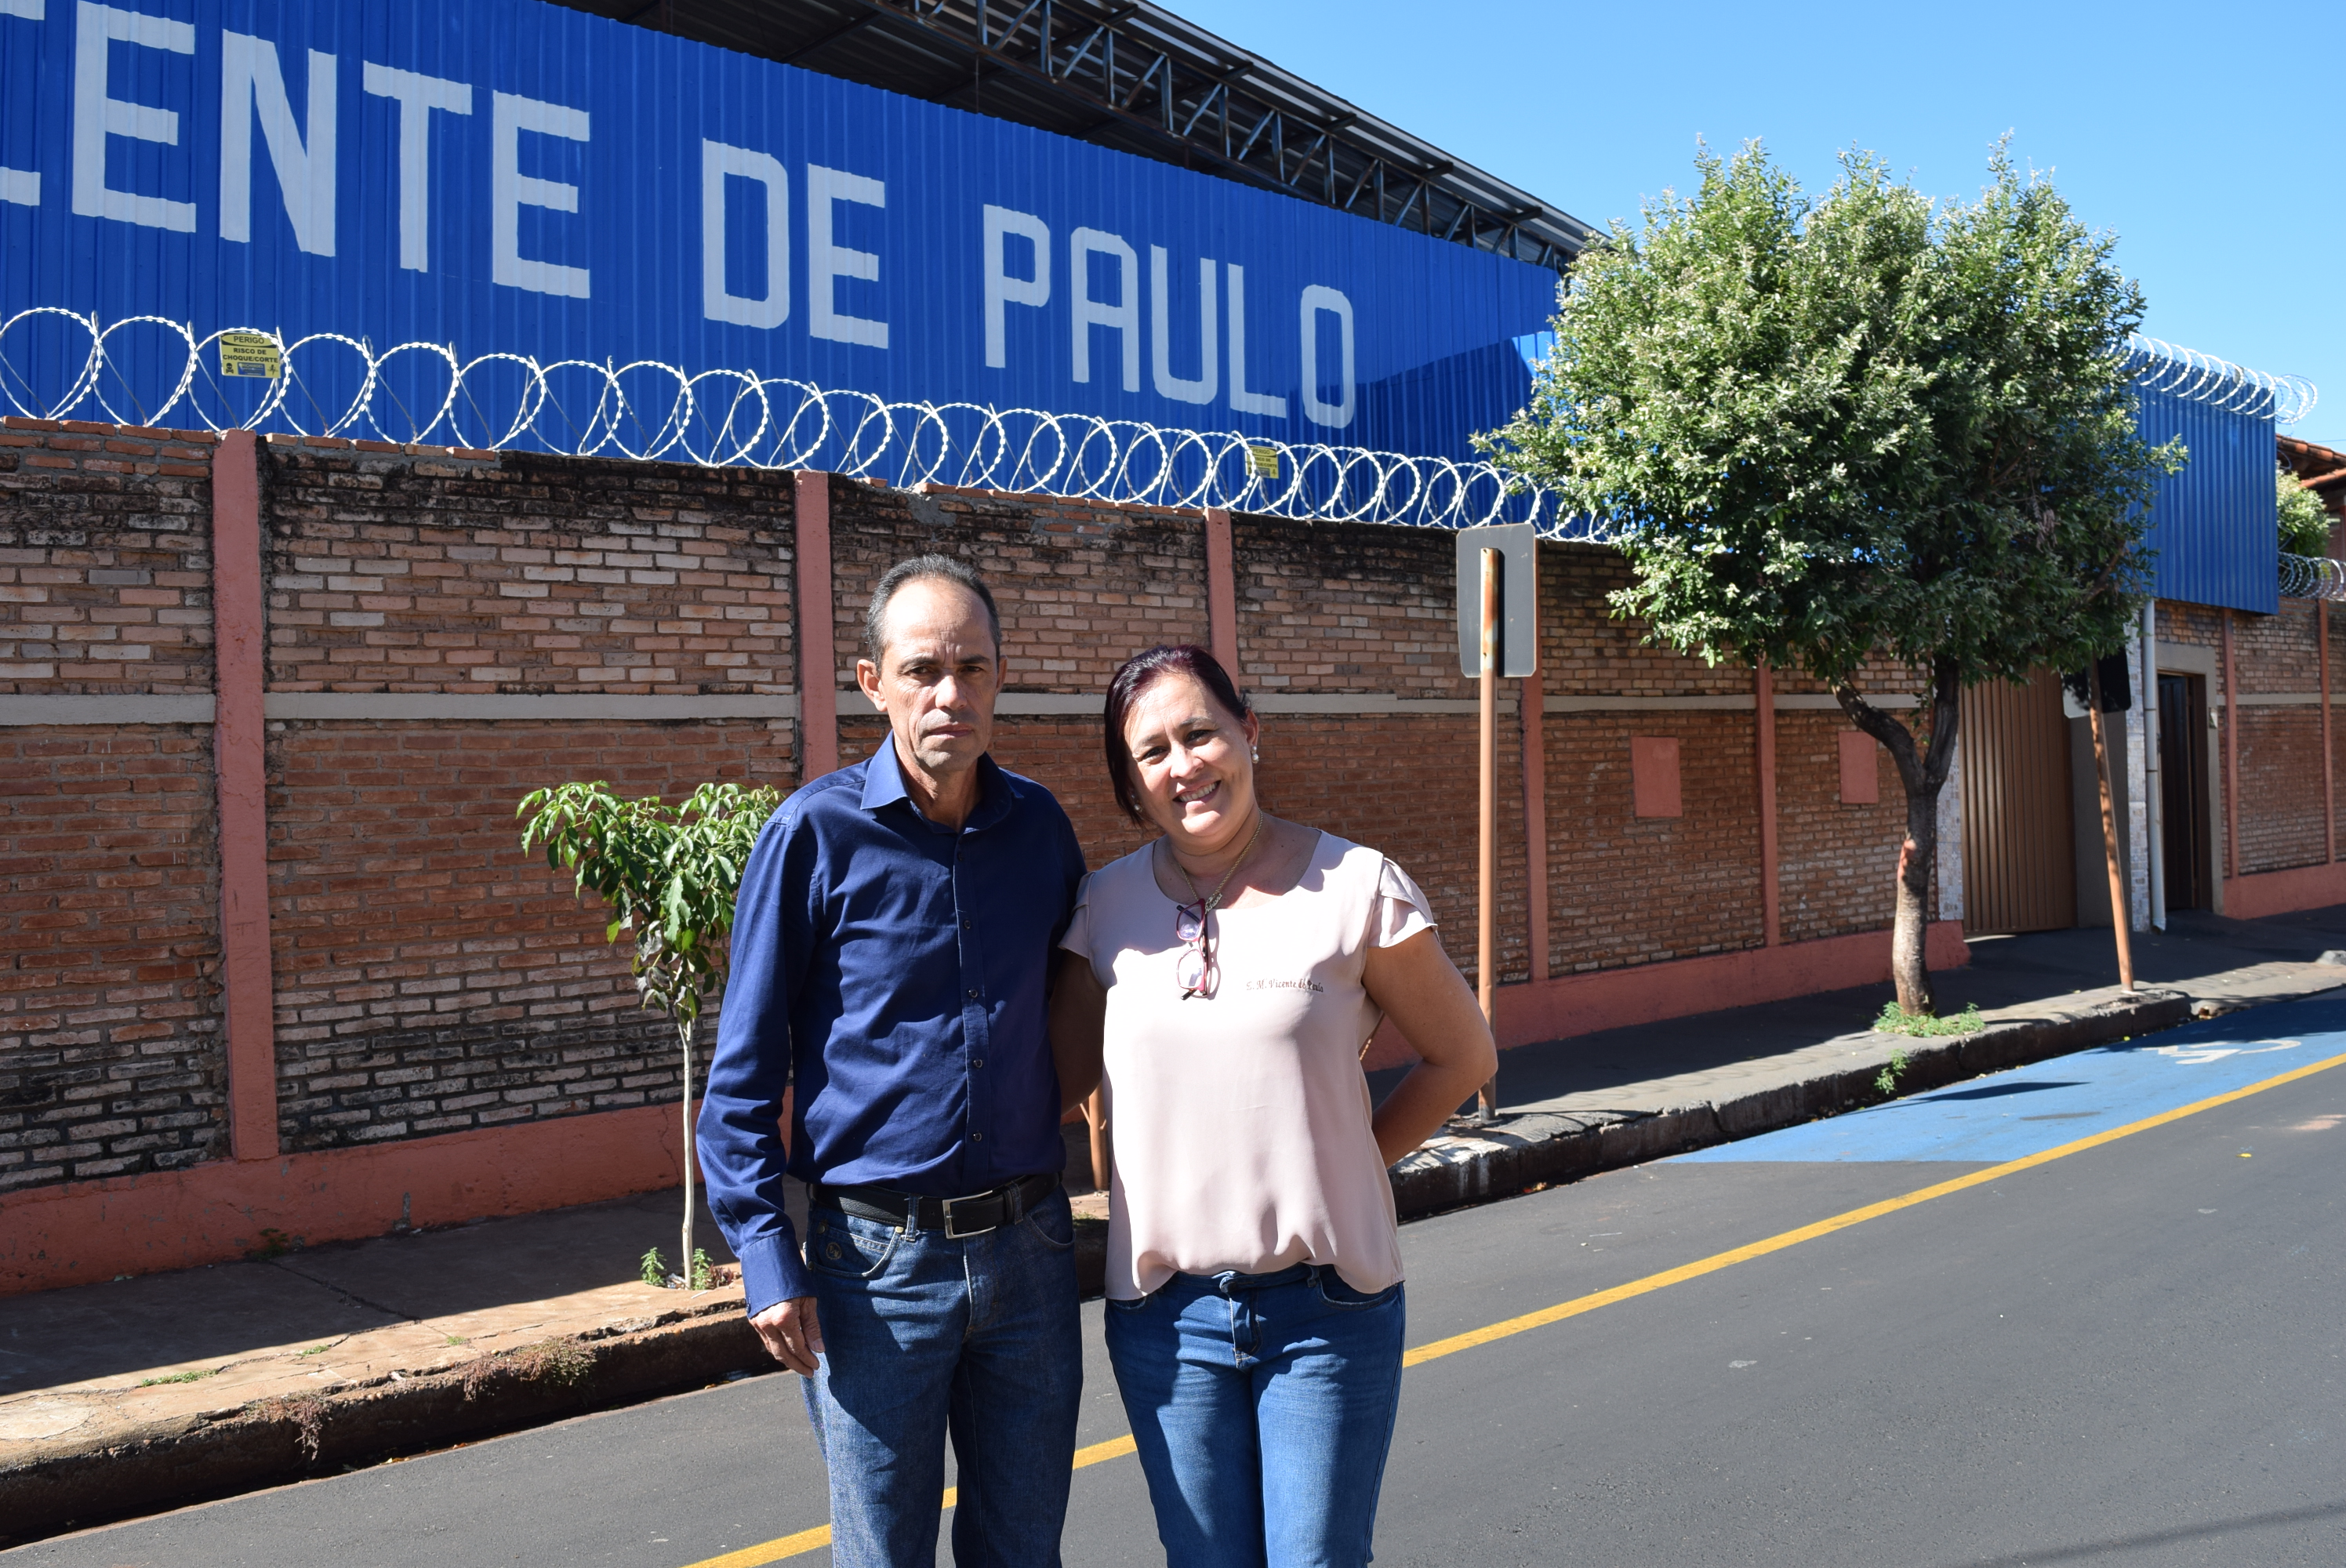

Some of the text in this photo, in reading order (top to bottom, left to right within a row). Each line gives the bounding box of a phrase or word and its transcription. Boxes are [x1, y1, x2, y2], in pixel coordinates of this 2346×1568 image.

[703, 138, 889, 350] DE
[983, 204, 1355, 430] PAULO
[234, 336, 264, 344] PERIGO
[223, 354, 278, 363] CHOQUE/CORTE
[1269, 978, 1297, 989] Vicente
